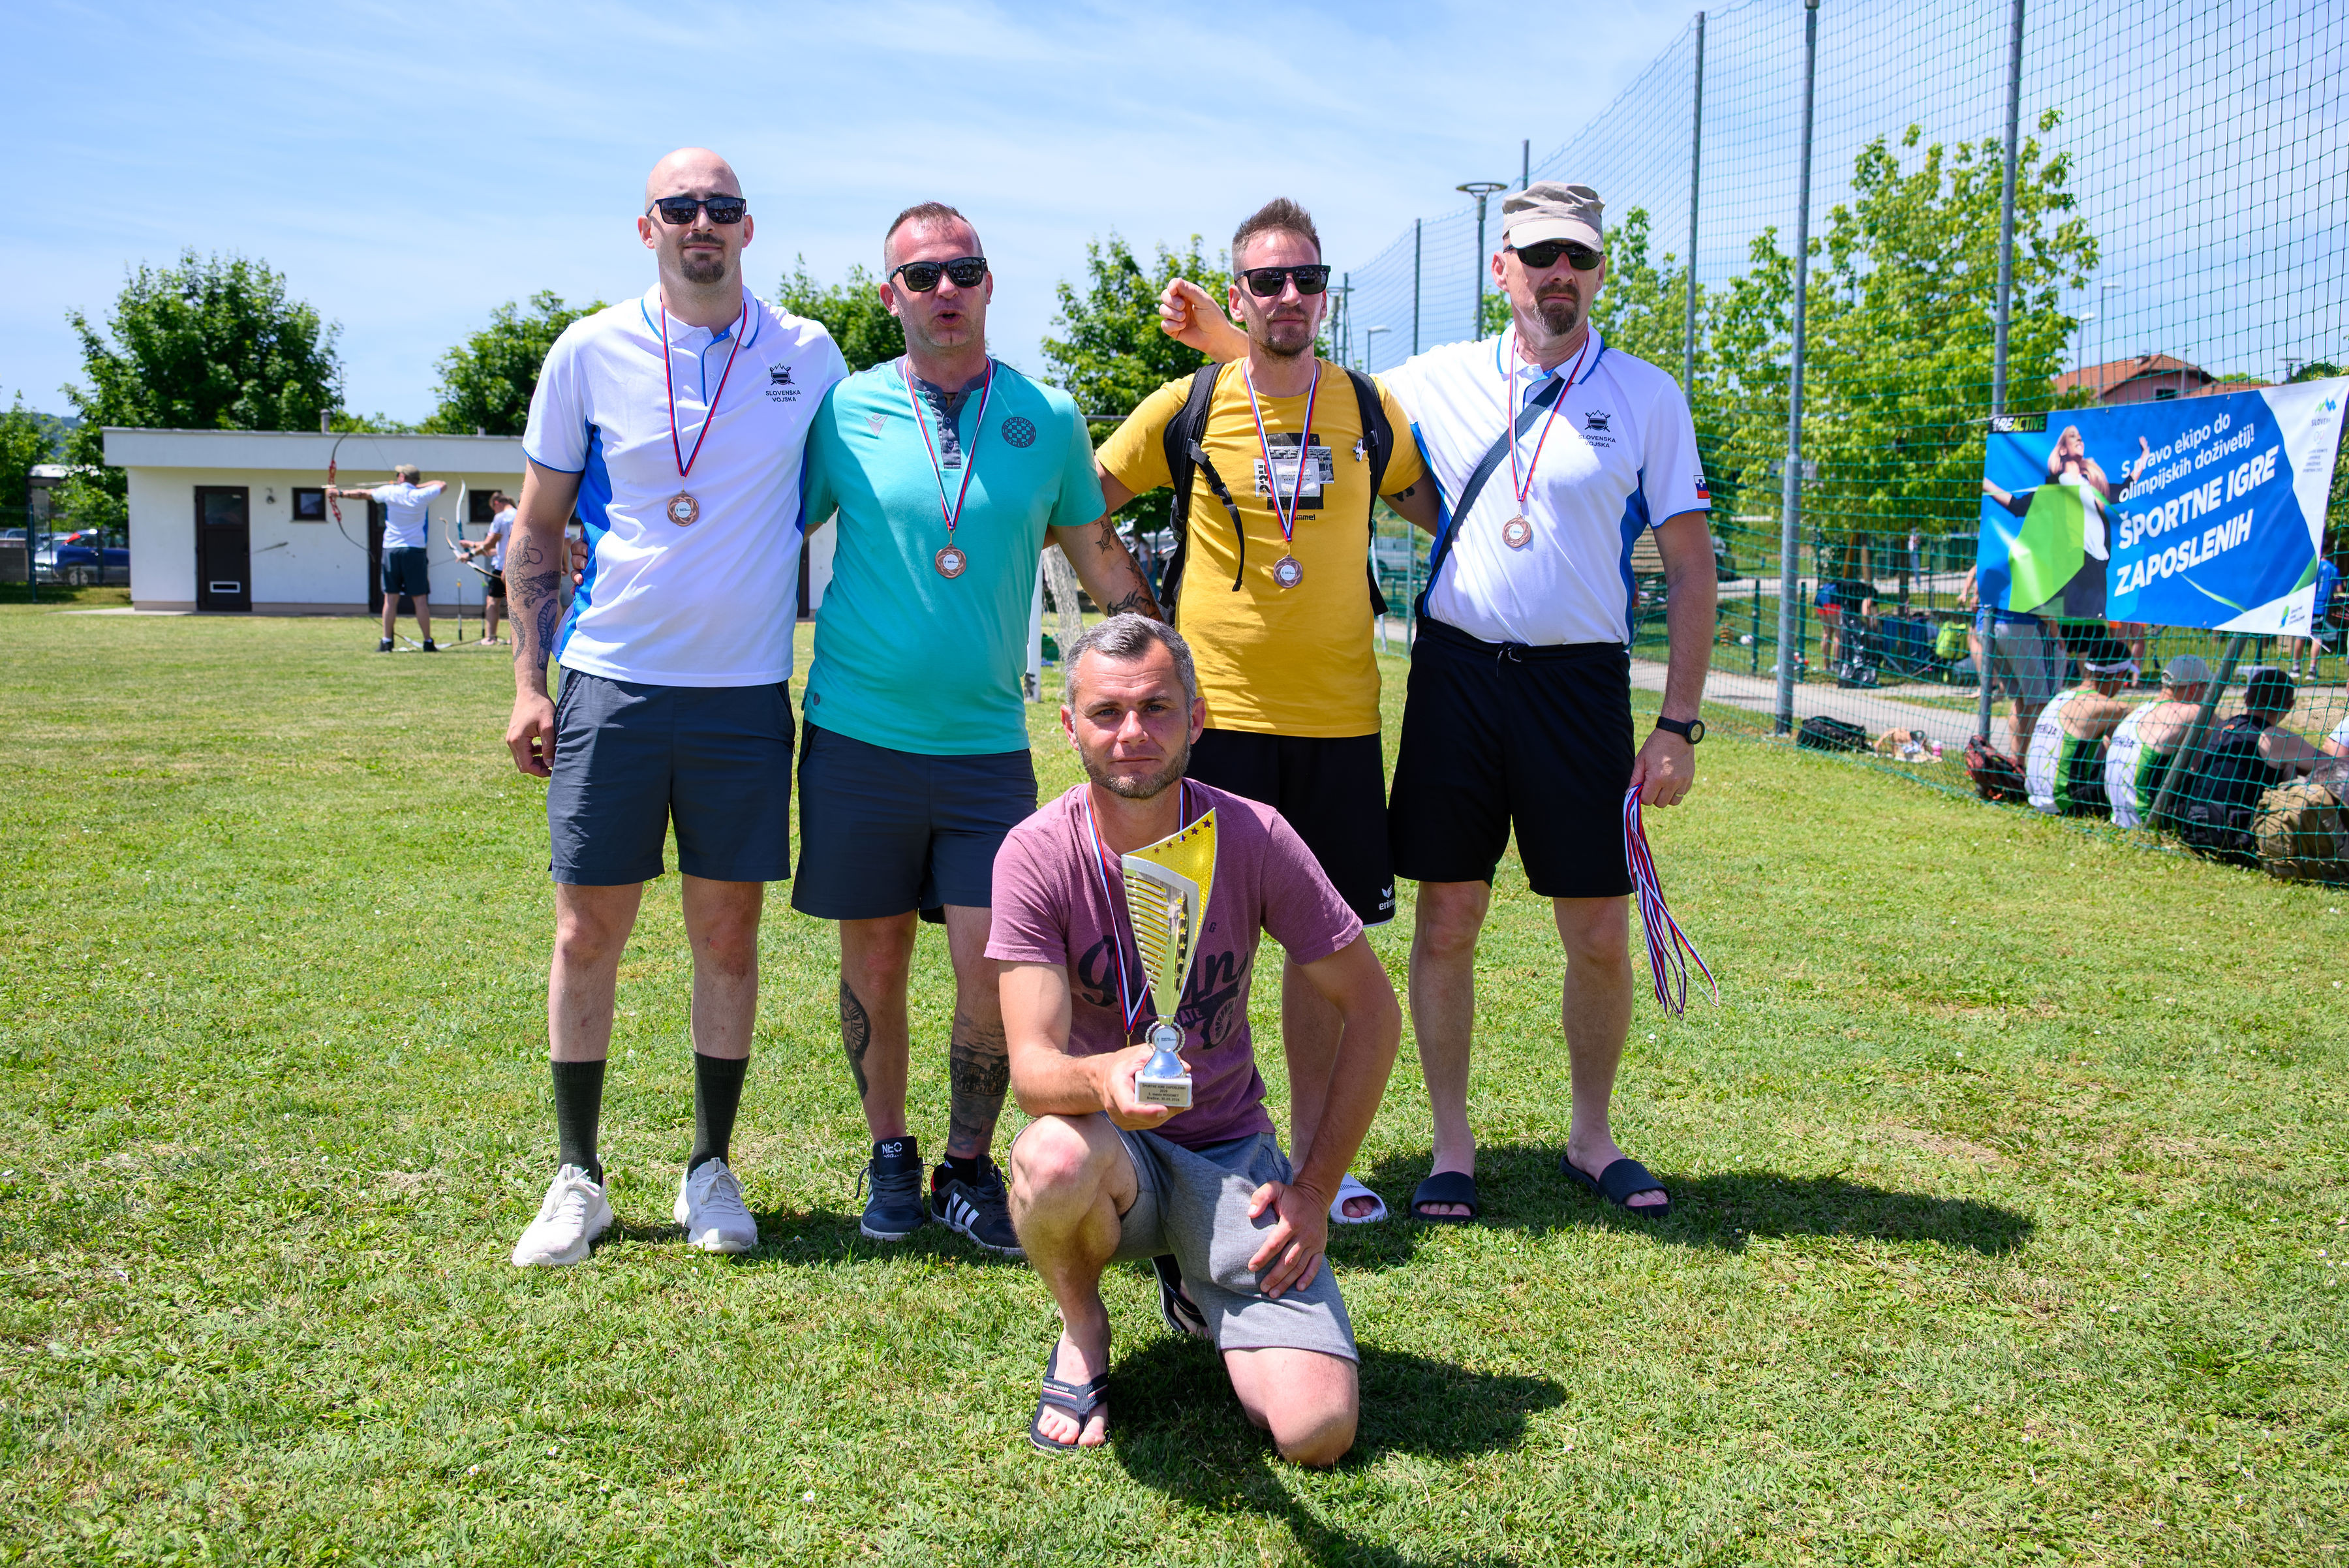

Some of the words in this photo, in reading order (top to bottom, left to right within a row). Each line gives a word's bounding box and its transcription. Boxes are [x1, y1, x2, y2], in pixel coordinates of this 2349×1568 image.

[1008, 438, 1029, 447] SPLIT
[1578, 435, 1616, 443] SLOVENSKA
[2119, 457, 2192, 502] olimpijskih
[2195, 423, 2255, 470] doživetij!
[2121, 459, 2130, 478] S
[2134, 445, 2172, 477] pravo
[2175, 425, 2211, 454] ekipo
[2214, 412, 2230, 435] do
[2119, 476, 2223, 549] ŠPORTNE
[2226, 445, 2279, 502] IGRE
[2114, 508, 2254, 597] ZAPOSLENIH
[882, 1142, 902, 1154] NEO
